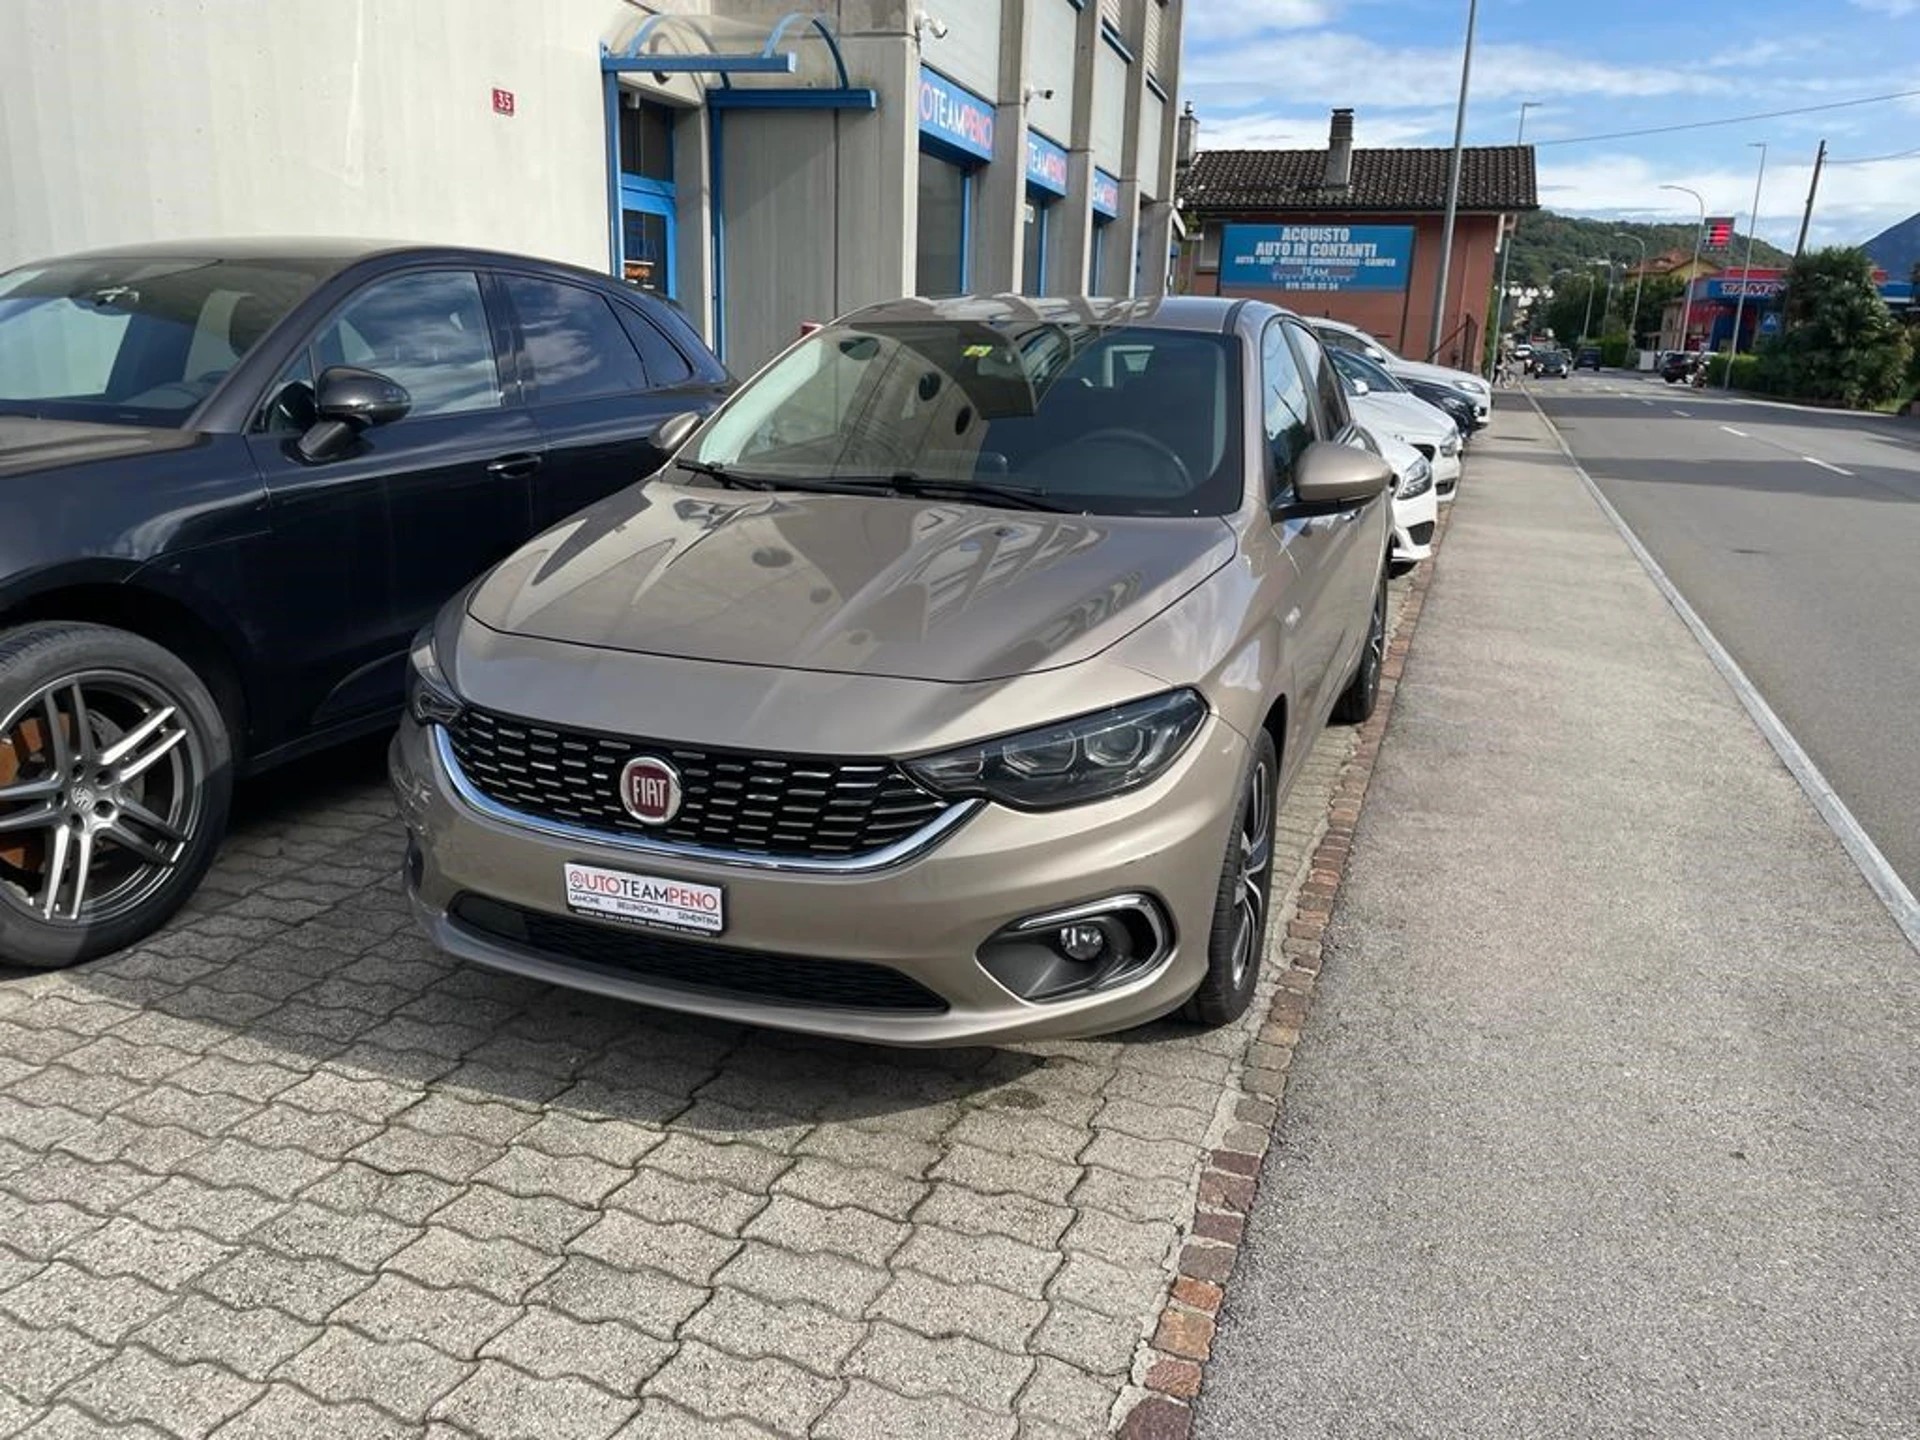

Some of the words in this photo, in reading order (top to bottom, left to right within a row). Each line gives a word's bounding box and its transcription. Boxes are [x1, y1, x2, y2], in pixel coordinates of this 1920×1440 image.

[1281, 227, 1350, 242] ACQUISTO
[1255, 242, 1291, 256] AUTO
[1293, 243, 1308, 256] IN
[1310, 243, 1377, 258] CONTANTI
[632, 775, 668, 808] FIAT
